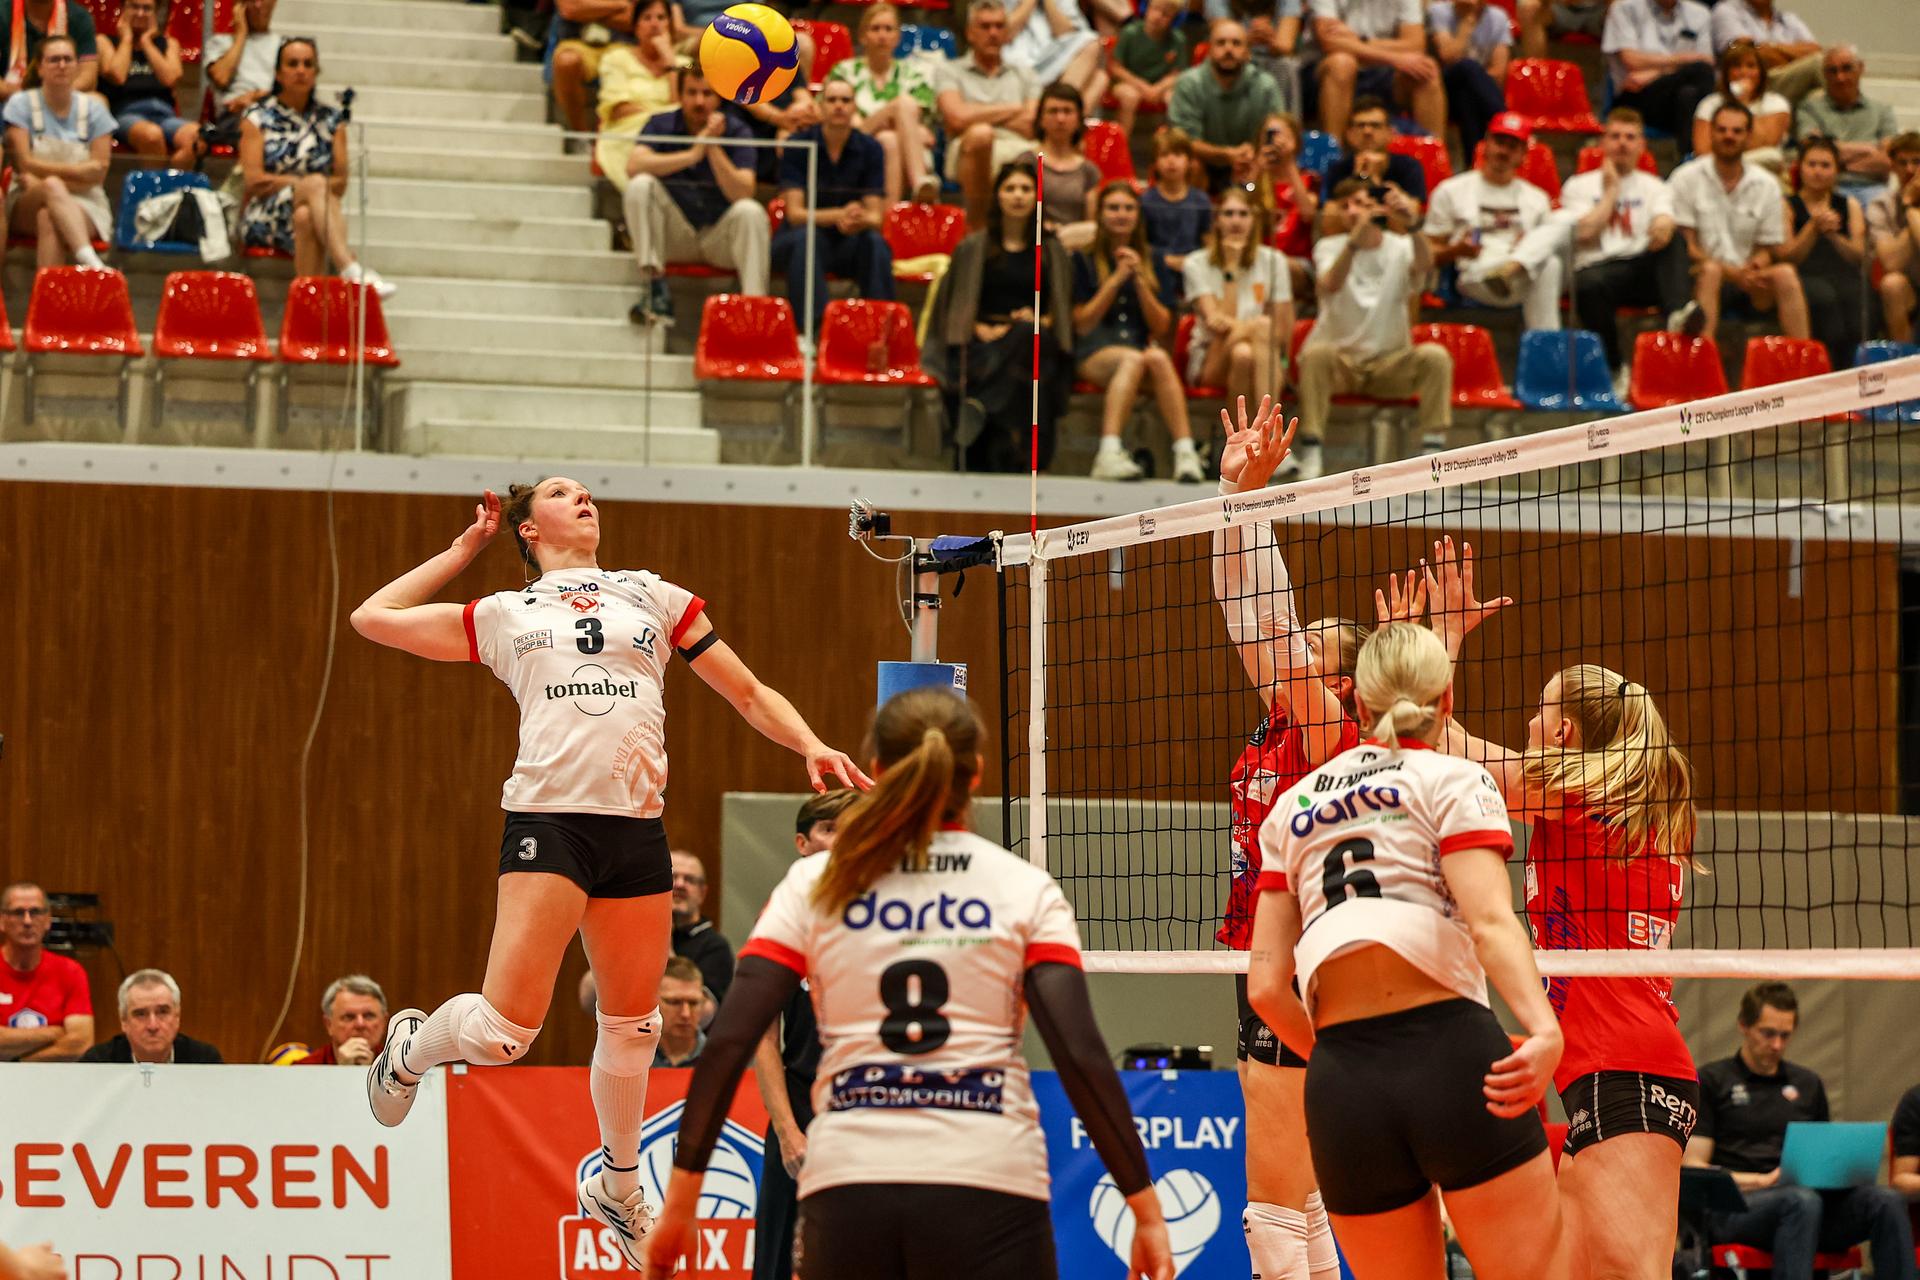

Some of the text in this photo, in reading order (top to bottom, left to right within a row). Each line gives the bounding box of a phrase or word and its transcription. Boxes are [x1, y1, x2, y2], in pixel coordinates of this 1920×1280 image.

[725, 22, 752, 35] V200W
[1695, 412, 1706, 424] CEV
[1706, 407, 1735, 423] Champions
[1735, 404, 1755, 417] League
[1754, 400, 1772, 413] Volley
[1444, 461, 1454, 472] CEV
[1454, 457, 1477, 471] Champions
[1477, 455, 1493, 467] League
[1492, 451, 1507, 463] Volley
[1242, 499, 1262, 512] Champions
[1261, 498, 1275, 509] League
[1275, 494, 1287, 506] Volley
[1076, 530, 1090, 545] CEV
[515, 631, 548, 645] REKKEN
[517, 640, 549, 656] SHOP.BE
[575, 617, 605, 655] 3
[545, 678, 638, 700] tomabel
[1291, 784, 1401, 838] darta
[518, 836, 538, 861] 3
[1322, 836, 1383, 912] 6
[843, 889, 992, 931] darta
[879, 958, 951, 1055] 8
[835, 1065, 1004, 1088] VOLVO
[829, 1085, 1004, 1110] AUTOMOBILIA
[1070, 1116, 1240, 1150] FRPLAY
[0, 1143, 391, 1210] EVEREN
